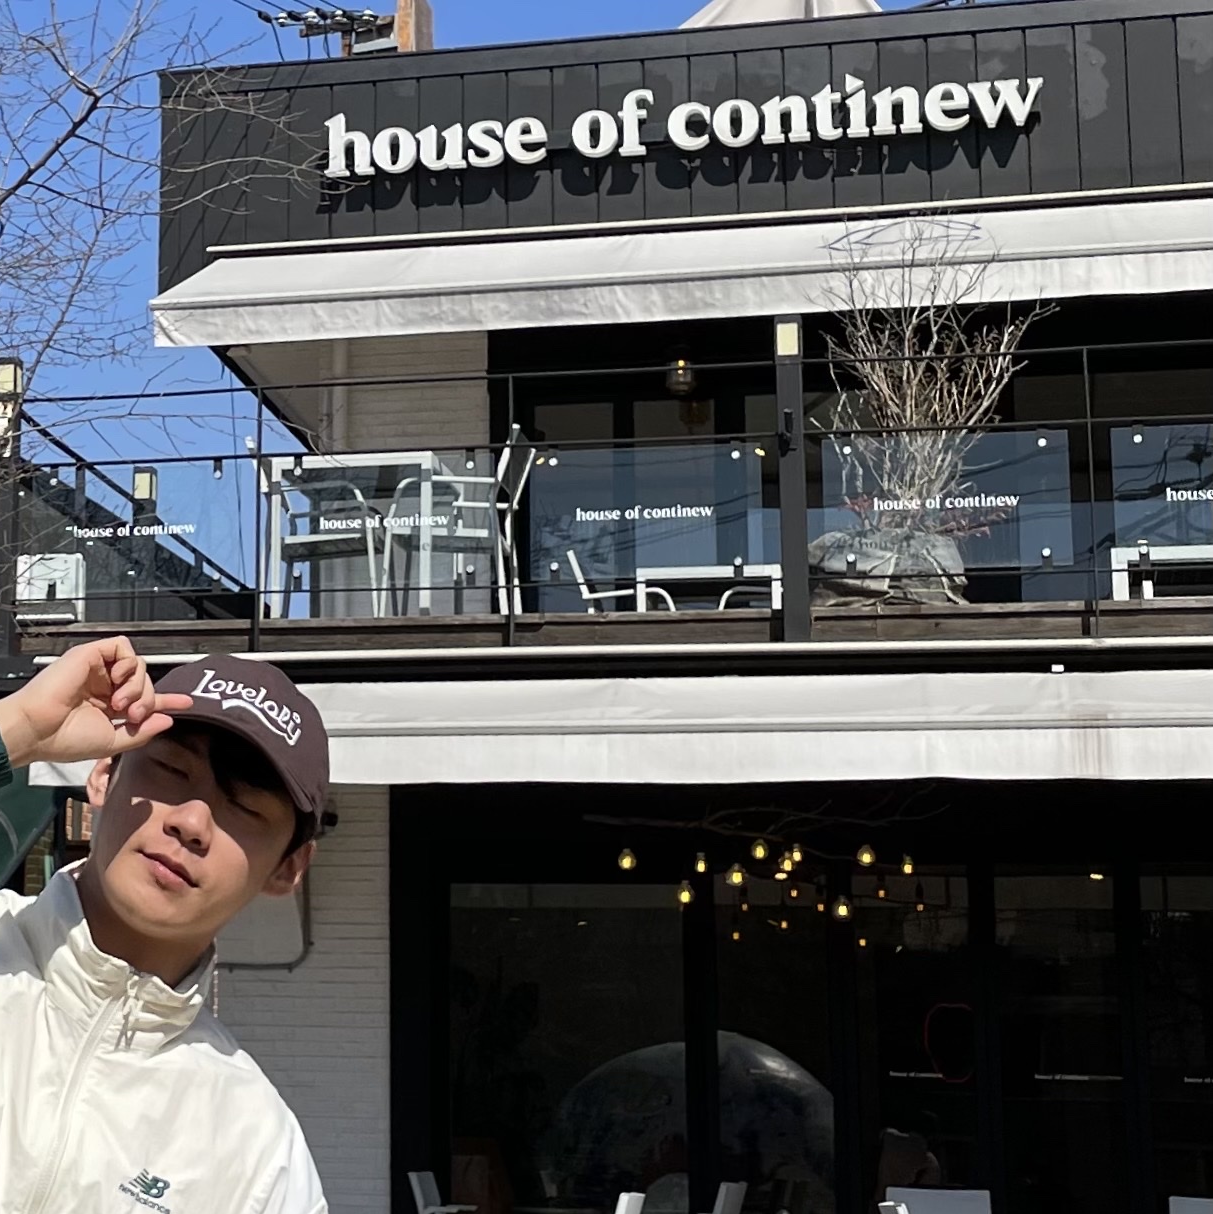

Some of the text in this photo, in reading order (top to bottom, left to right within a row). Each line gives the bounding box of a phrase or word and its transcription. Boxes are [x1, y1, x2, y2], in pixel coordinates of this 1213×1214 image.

[323, 73, 1045, 178] house of continew
[873, 493, 1020, 511] house of continew
[1166, 487, 1213, 501] house
[575, 503, 714, 521] house of continew
[319, 513, 449, 530] house of continew
[73, 525, 114, 538] house
